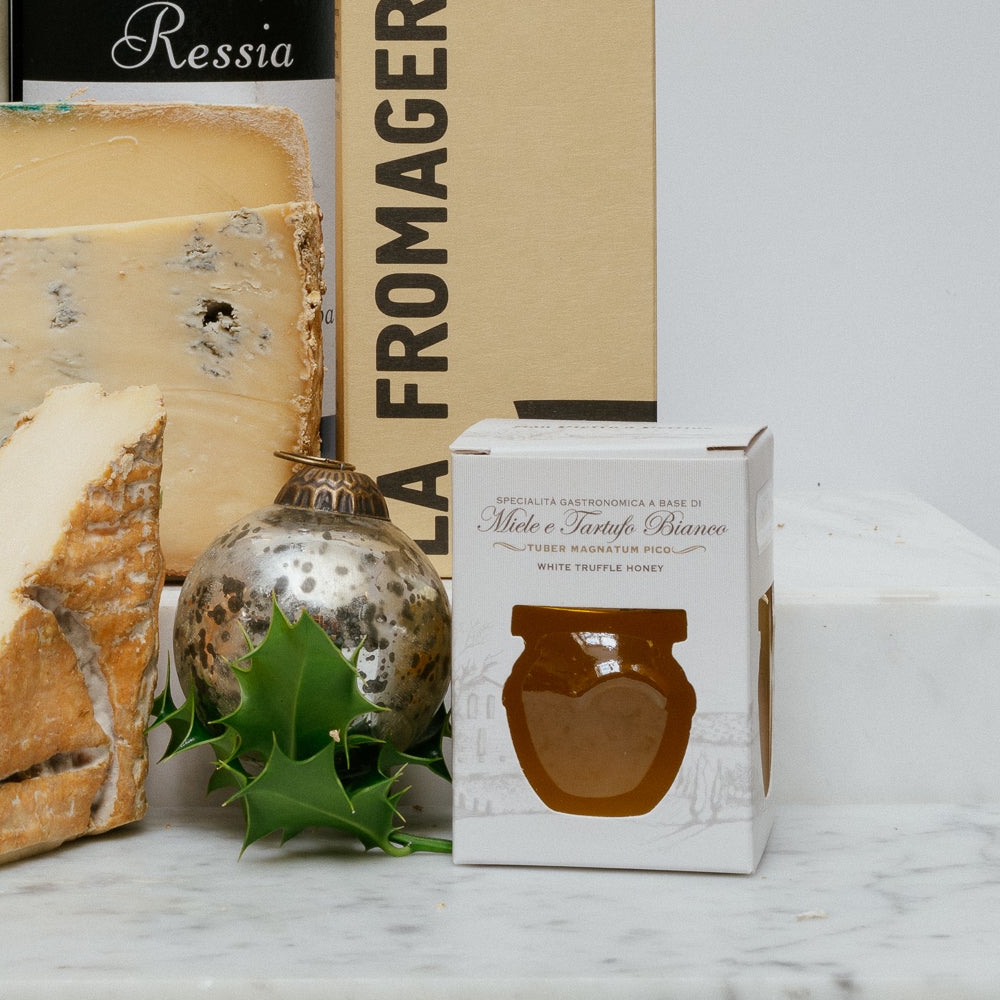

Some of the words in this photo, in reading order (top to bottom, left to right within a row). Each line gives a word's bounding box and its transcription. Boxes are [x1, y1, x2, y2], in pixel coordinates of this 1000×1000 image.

[111, 1, 294, 69] Ressia
[376, 459, 449, 556] LA
[496, 496, 556, 507] SPECIALITÀ
[560, 498, 646, 507] GASTRONOMICA
[649, 499, 656, 508] A
[659, 499, 688, 508] BASE
[691, 499, 702, 508] DI
[477, 505, 540, 535] Miele
[544, 523, 555, 534] e
[560, 508, 637, 544] Tartufo
[643, 510, 729, 537] Bianco
[527, 543, 566, 553] TUBER
[570, 544, 639, 554] MAGNATUM
[643, 545, 672, 554] PICO
[537, 562, 572, 572] WHITE
[575, 563, 623, 573] TRUFFLE
[626, 563, 664, 573] HONEY
